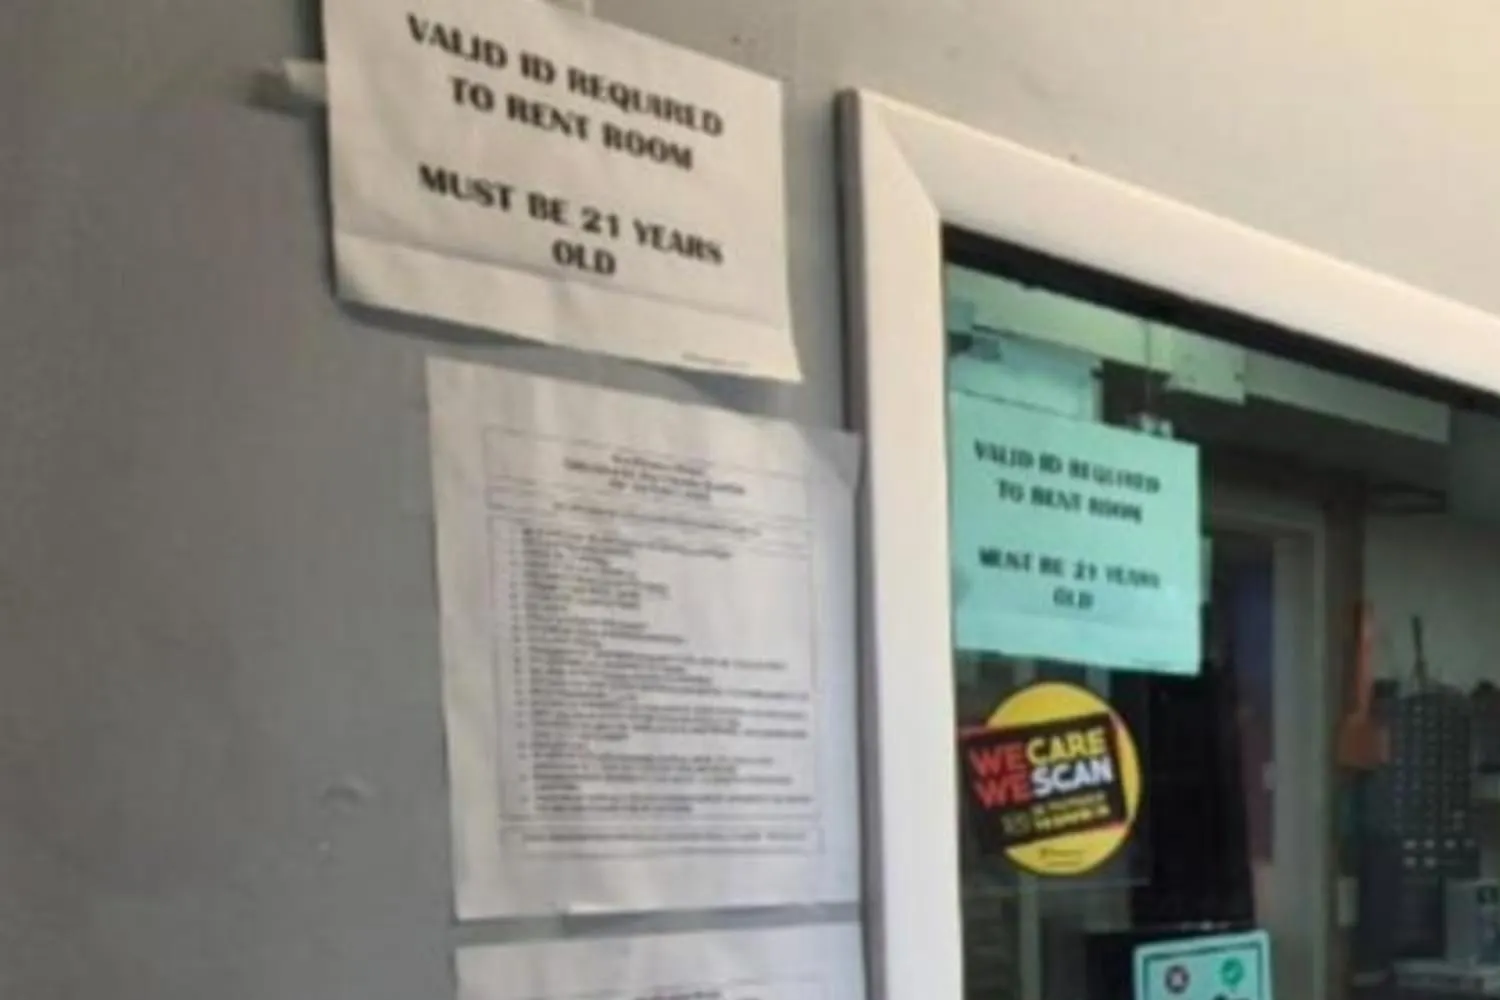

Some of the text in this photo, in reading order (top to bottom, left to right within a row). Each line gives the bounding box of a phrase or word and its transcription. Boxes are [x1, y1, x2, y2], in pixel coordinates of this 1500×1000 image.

[406, 13, 724, 138] VALID ID REQUIRED
[449, 76, 695, 172] TO RENT ROOM
[418, 161, 724, 266] MUST BE 21 YEARS
[551, 239, 617, 277] OLD
[969, 726, 1107, 777] WE CARE
[1031, 756, 1113, 798] SCAN
